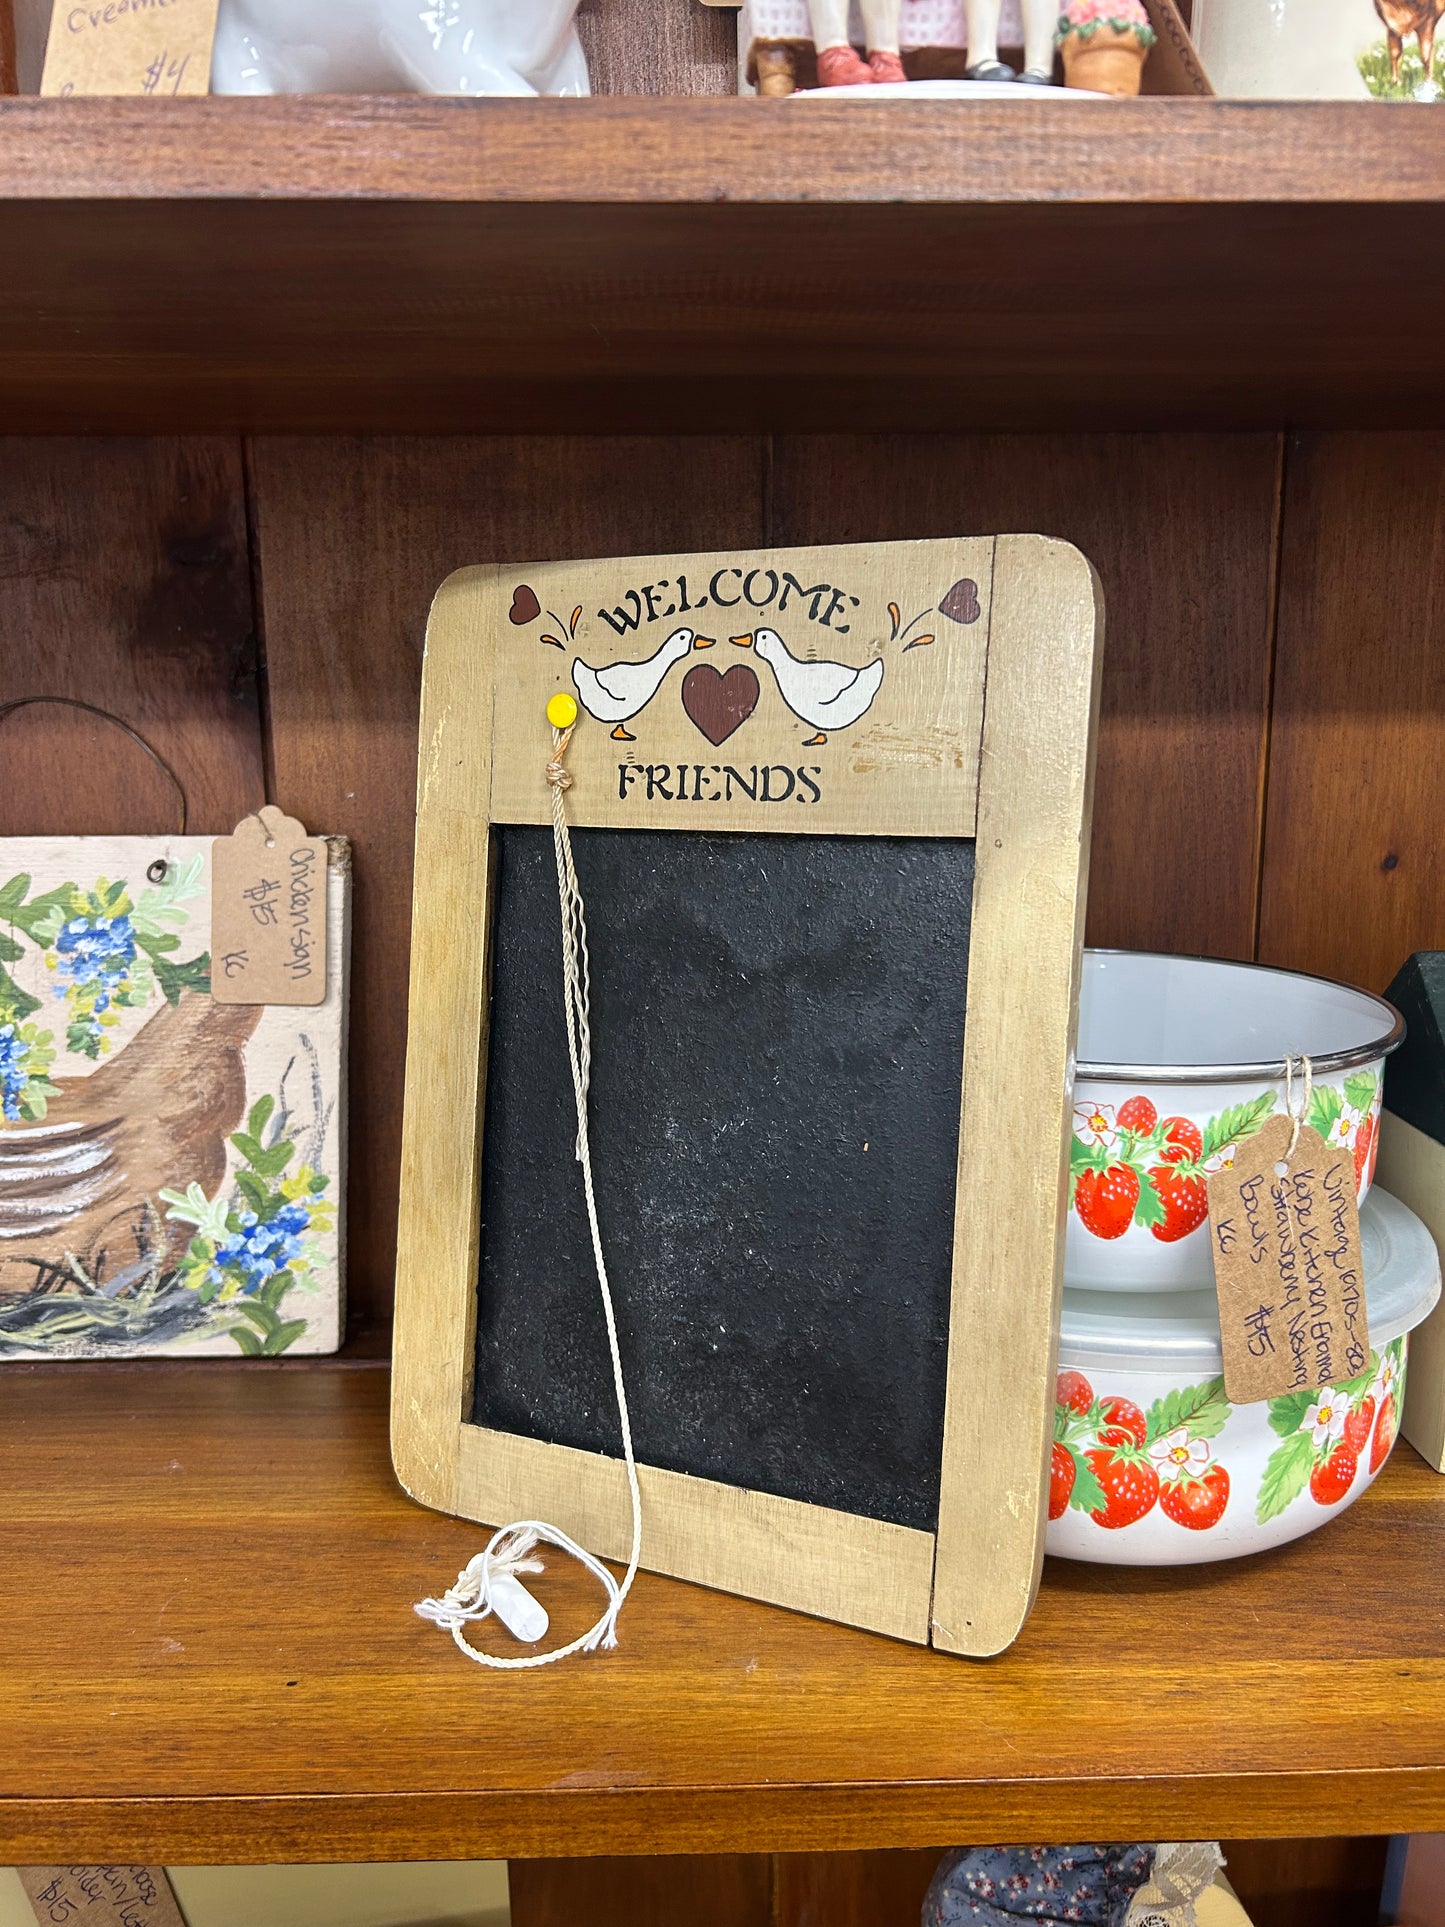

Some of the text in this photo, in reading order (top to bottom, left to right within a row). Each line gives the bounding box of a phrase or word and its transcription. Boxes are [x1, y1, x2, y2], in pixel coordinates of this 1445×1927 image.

[141, 52, 191, 96] $4
[598, 569, 860, 635] WELCOME
[618, 764, 822, 803] FRIENDS
[243, 879, 281, 925] $15
[283, 848, 316, 980] Chicken sign
[1239, 1174, 1269, 1264] Bowls
[1323, 1163, 1350, 1269] Vintage
[1270, 1177, 1308, 1388] Strawberry Nesting
[1300, 1228, 1329, 1317] Kitchen
[1310, 1321, 1335, 1385] Enamel
[36, 1876, 78, 1922] $15
[68, 1865, 106, 1905] older
